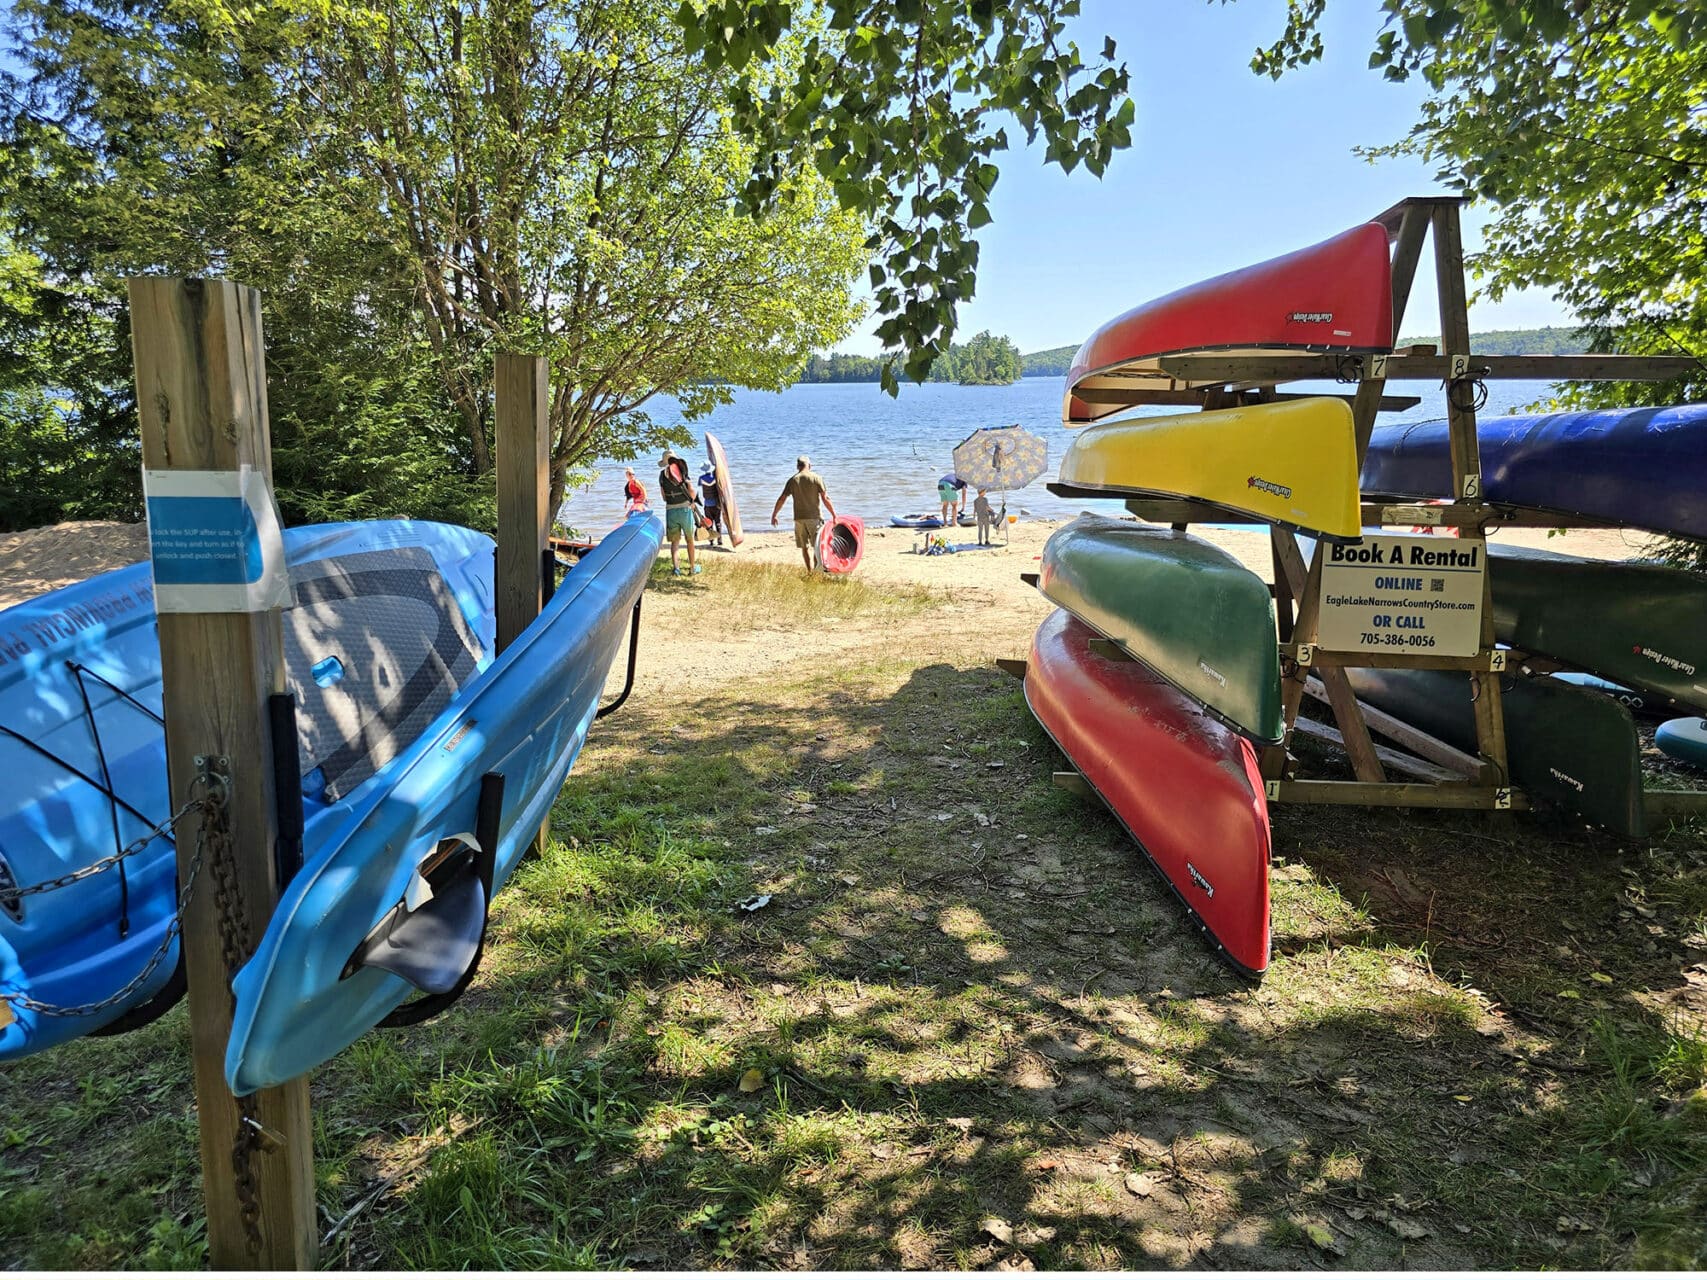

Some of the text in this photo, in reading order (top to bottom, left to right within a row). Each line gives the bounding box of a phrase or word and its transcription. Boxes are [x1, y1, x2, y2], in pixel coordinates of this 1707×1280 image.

[1374, 359, 1385, 376] 7
[1454, 358, 1465, 376] 8
[1465, 476, 1477, 497] 6
[184, 528, 199, 537] SUP
[1331, 542, 1478, 568] Book A Rental
[1375, 576, 1423, 591] ONLINE
[1326, 594, 1476, 611] EagleLakeNarrowsCountryStore.com
[22, 592, 137, 648] PROVINCIAL
[1373, 614, 1426, 630] OR CALL
[1360, 632, 1436, 648] 705-386-0056
[1300, 646, 1311, 662] 3
[1492, 655, 1504, 669] 4
[1661, 655, 1696, 676] ClearWater
[1550, 767, 1584, 792] Kawartha
[1186, 862, 1214, 898] Kawartha
